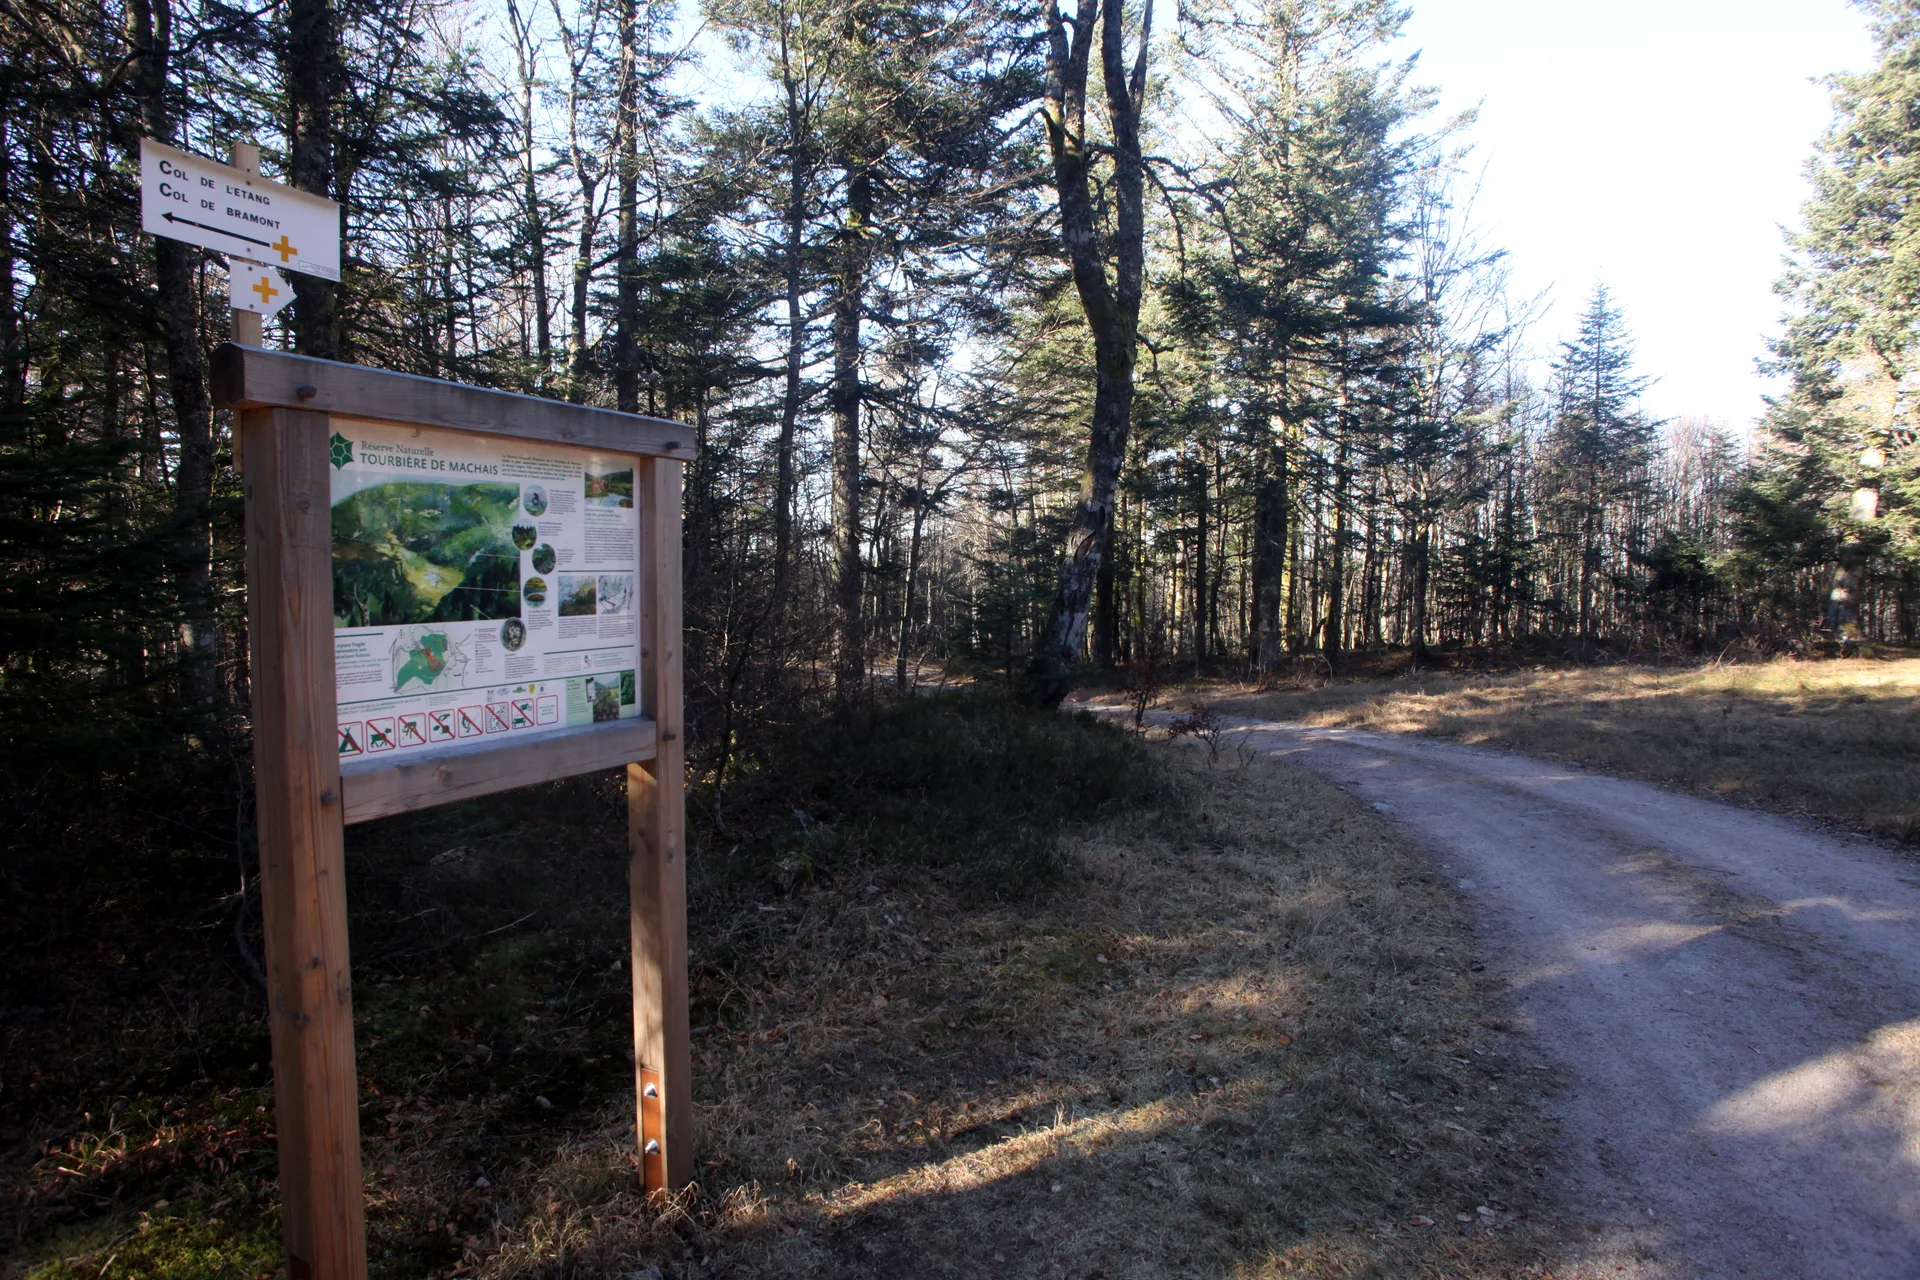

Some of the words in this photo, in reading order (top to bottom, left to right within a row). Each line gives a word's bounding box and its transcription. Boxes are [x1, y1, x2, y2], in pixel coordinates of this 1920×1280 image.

[200, 177, 215, 189] DE
[226, 185, 270, 205] L'ETANG
[200, 199, 215, 211] DE
[226, 206, 281, 229] BRAMONT
[360, 440, 394, 453] Réserve
[396, 444, 434, 457] Naturelle
[360, 453, 427, 470] TOURBIÈRE
[431, 459, 446, 471] DE
[449, 461, 498, 476] MACHAIS
